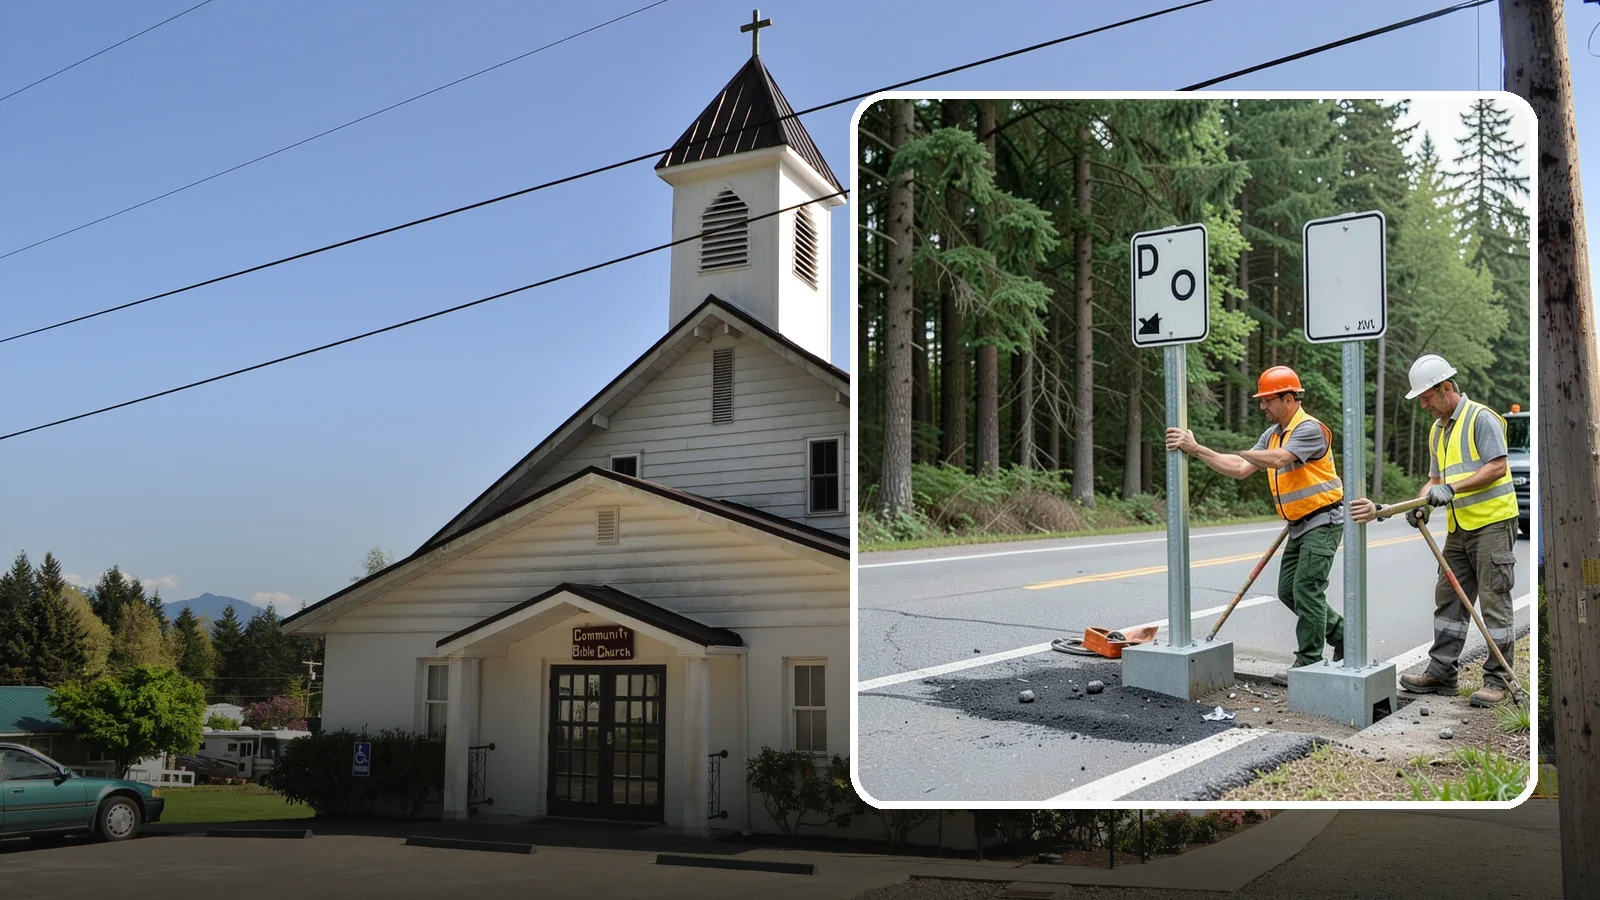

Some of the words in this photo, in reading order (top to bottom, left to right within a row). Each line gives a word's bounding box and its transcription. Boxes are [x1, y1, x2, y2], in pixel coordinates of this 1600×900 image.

[574, 627, 628, 641] Community
[572, 644, 595, 657] Bible
[597, 645, 631, 658] Church
